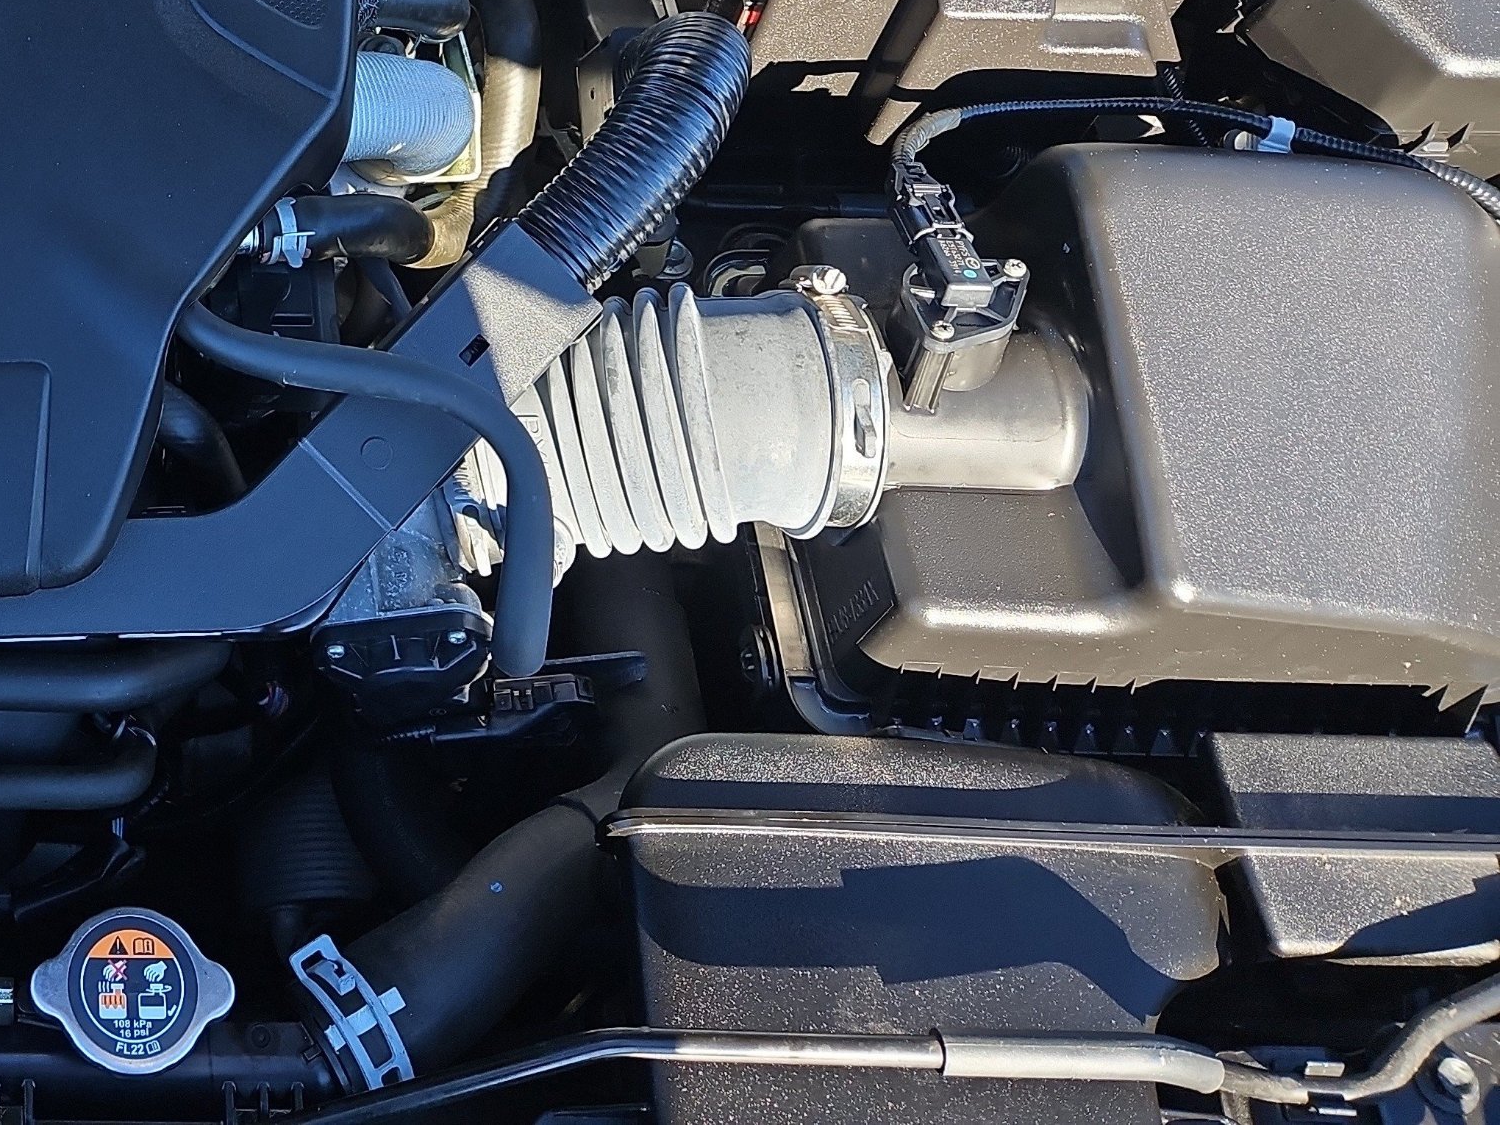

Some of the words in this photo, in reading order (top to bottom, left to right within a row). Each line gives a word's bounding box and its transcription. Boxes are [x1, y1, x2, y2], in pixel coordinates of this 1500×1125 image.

[113, 1019, 131, 1028] 108
[133, 1019, 153, 1028] kPa
[120, 1029, 132, 1038] 16
[134, 1027, 150, 1038] psi
[115, 1041, 145, 1055] FL22
